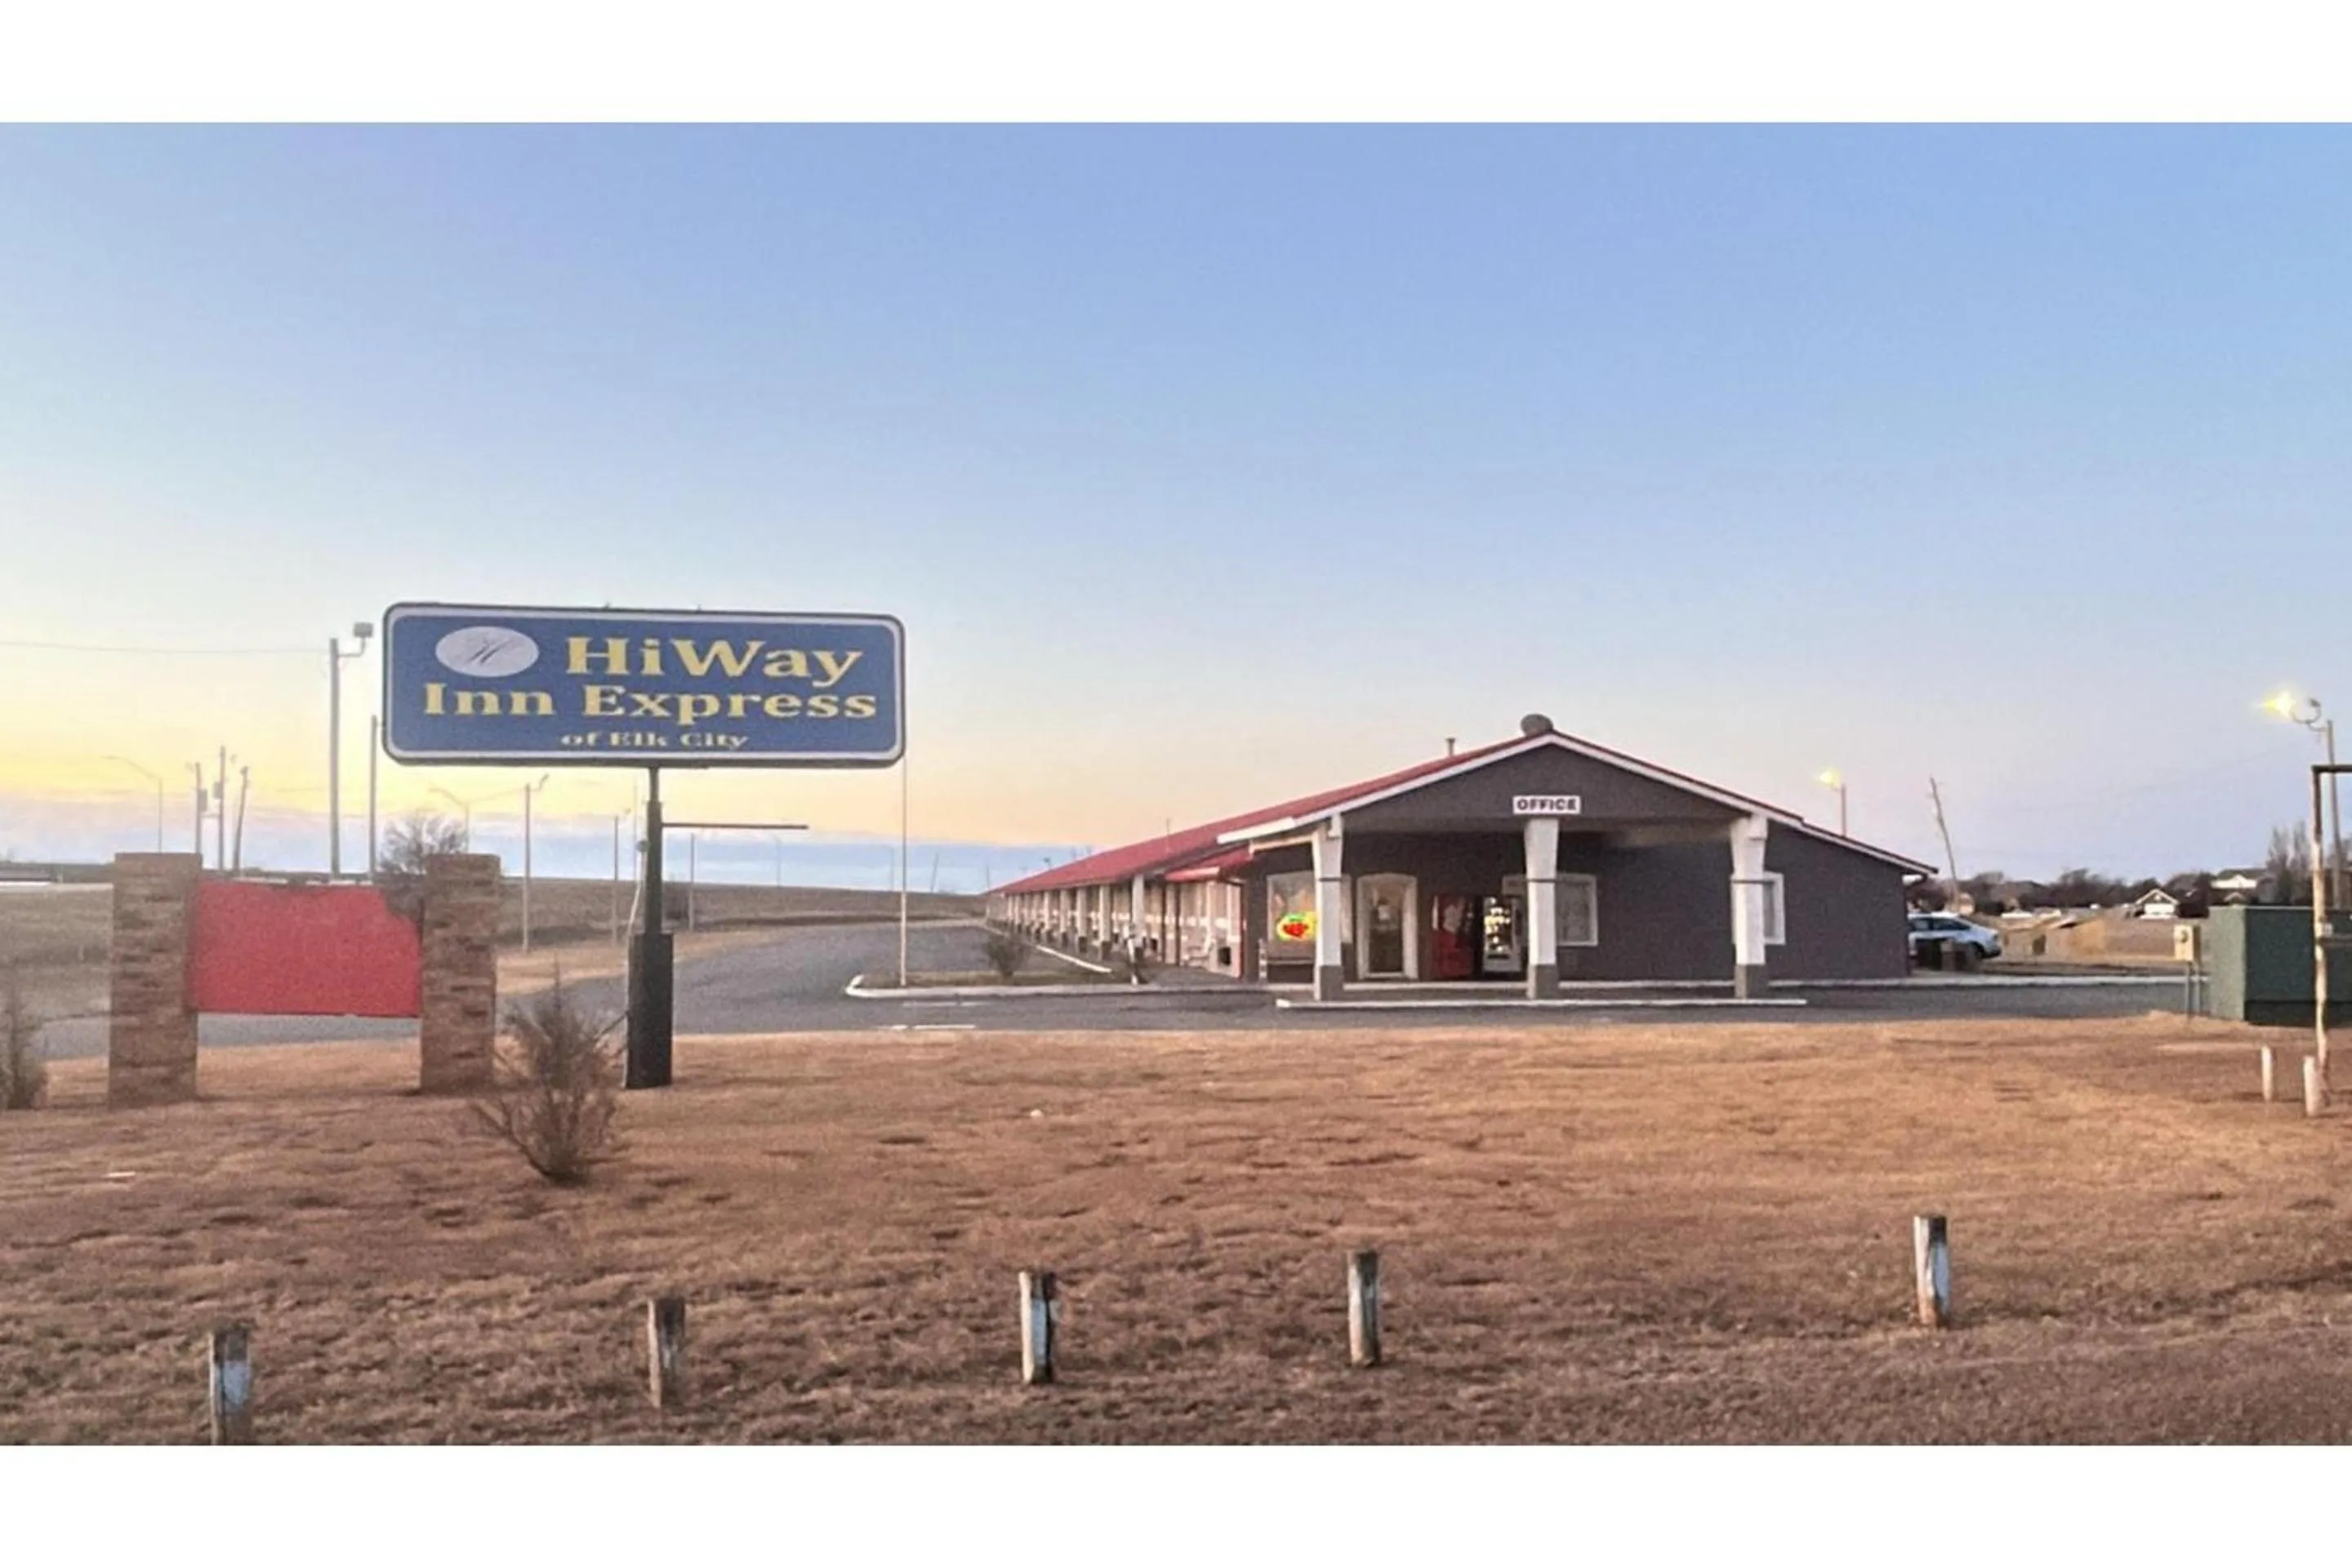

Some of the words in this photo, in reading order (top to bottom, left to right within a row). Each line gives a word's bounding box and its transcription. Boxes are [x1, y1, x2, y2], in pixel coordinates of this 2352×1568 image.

[565, 636, 864, 688] HiWay
[423, 682, 556, 716] Inn
[582, 684, 877, 726] Express
[560, 732, 601, 746] of
[610, 732, 668, 746] Elk
[679, 732, 750, 750] City
[1517, 798, 1577, 811] OFFICE
